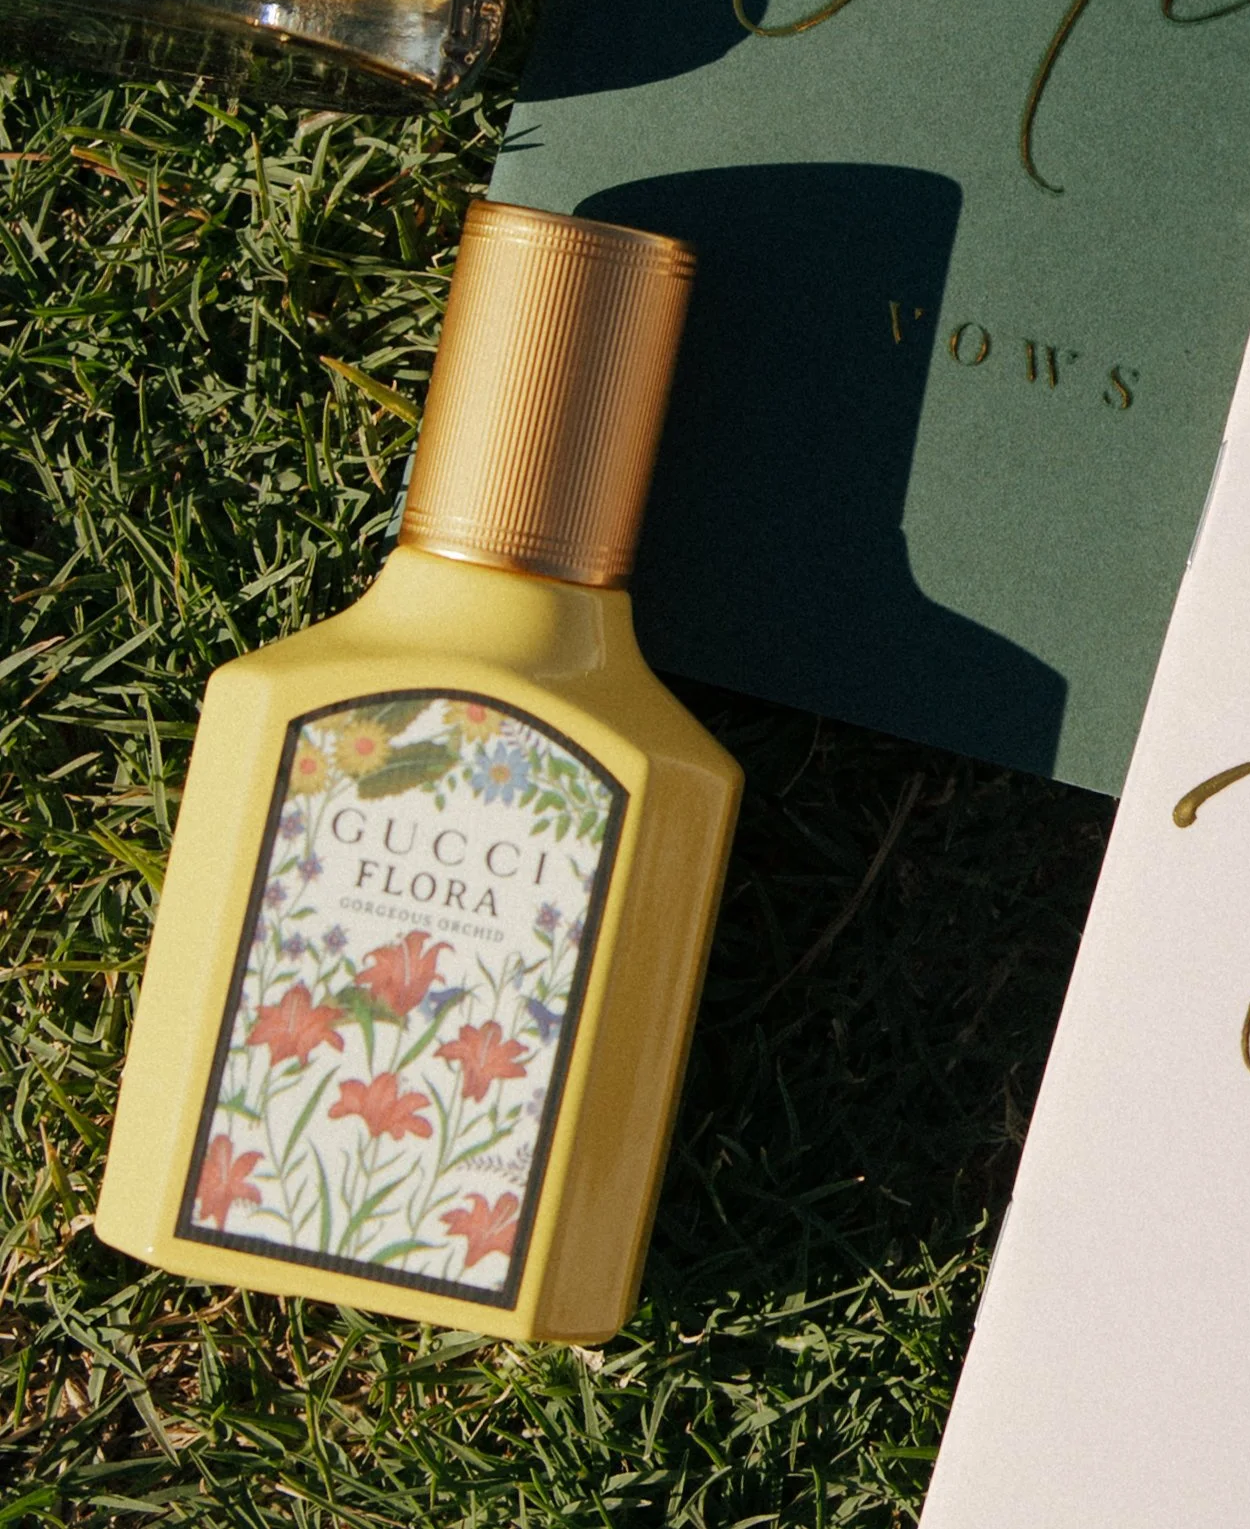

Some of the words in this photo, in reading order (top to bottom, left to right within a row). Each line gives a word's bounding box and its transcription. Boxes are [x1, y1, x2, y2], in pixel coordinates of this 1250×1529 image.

[889, 300, 1140, 410] VOWS
[332, 807, 547, 885] GUCCI
[340, 896, 432, 927] GORGEOUS
[437, 918, 505, 944] ORCHID
[355, 859, 498, 917] FLORA
